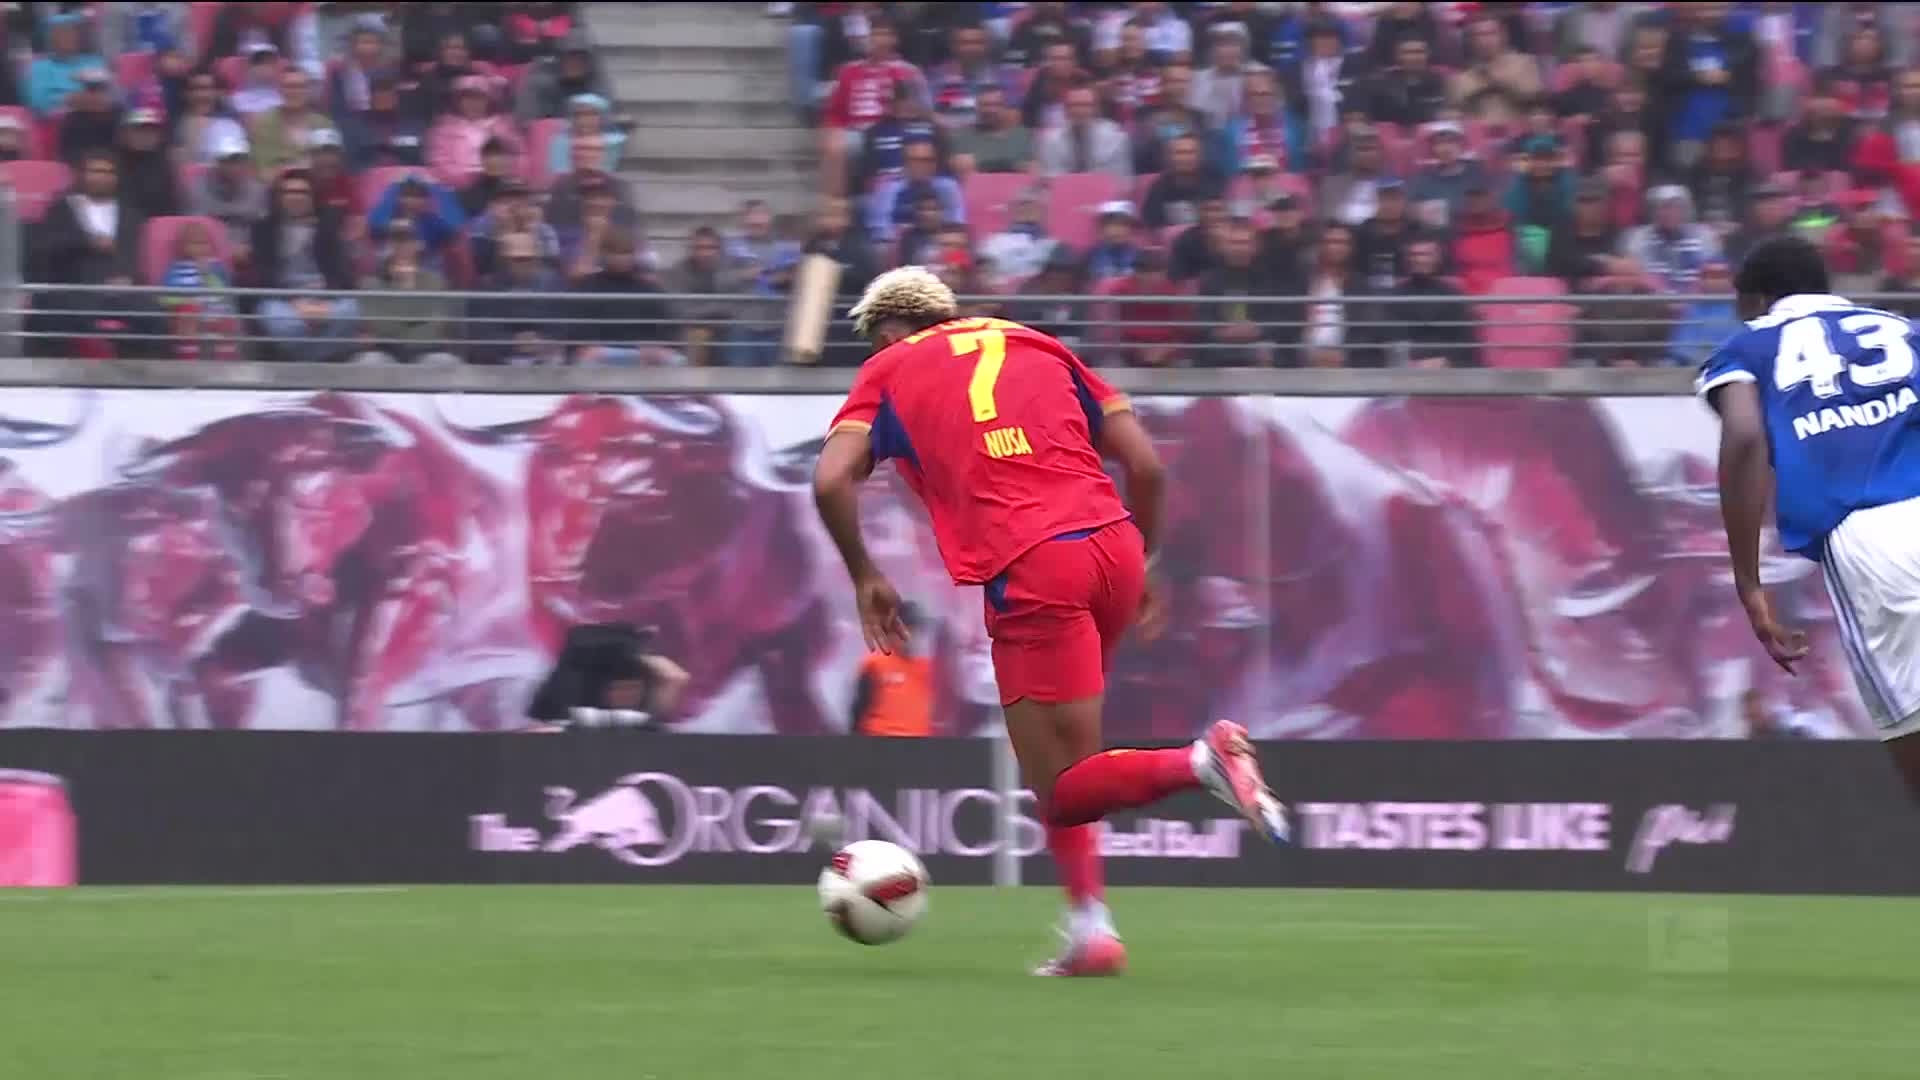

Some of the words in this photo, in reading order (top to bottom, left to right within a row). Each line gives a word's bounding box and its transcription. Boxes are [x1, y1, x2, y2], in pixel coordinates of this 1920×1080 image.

[948, 328, 1006, 423] 7
[1774, 313, 1915, 399] 43
[983, 426, 1033, 459] NUSA
[1792, 387, 1918, 440] NANDJA
[611, 772, 1047, 866] ORGANICS
[1299, 801, 1487, 850] TASTES
[1493, 802, 1612, 851] LIKE
